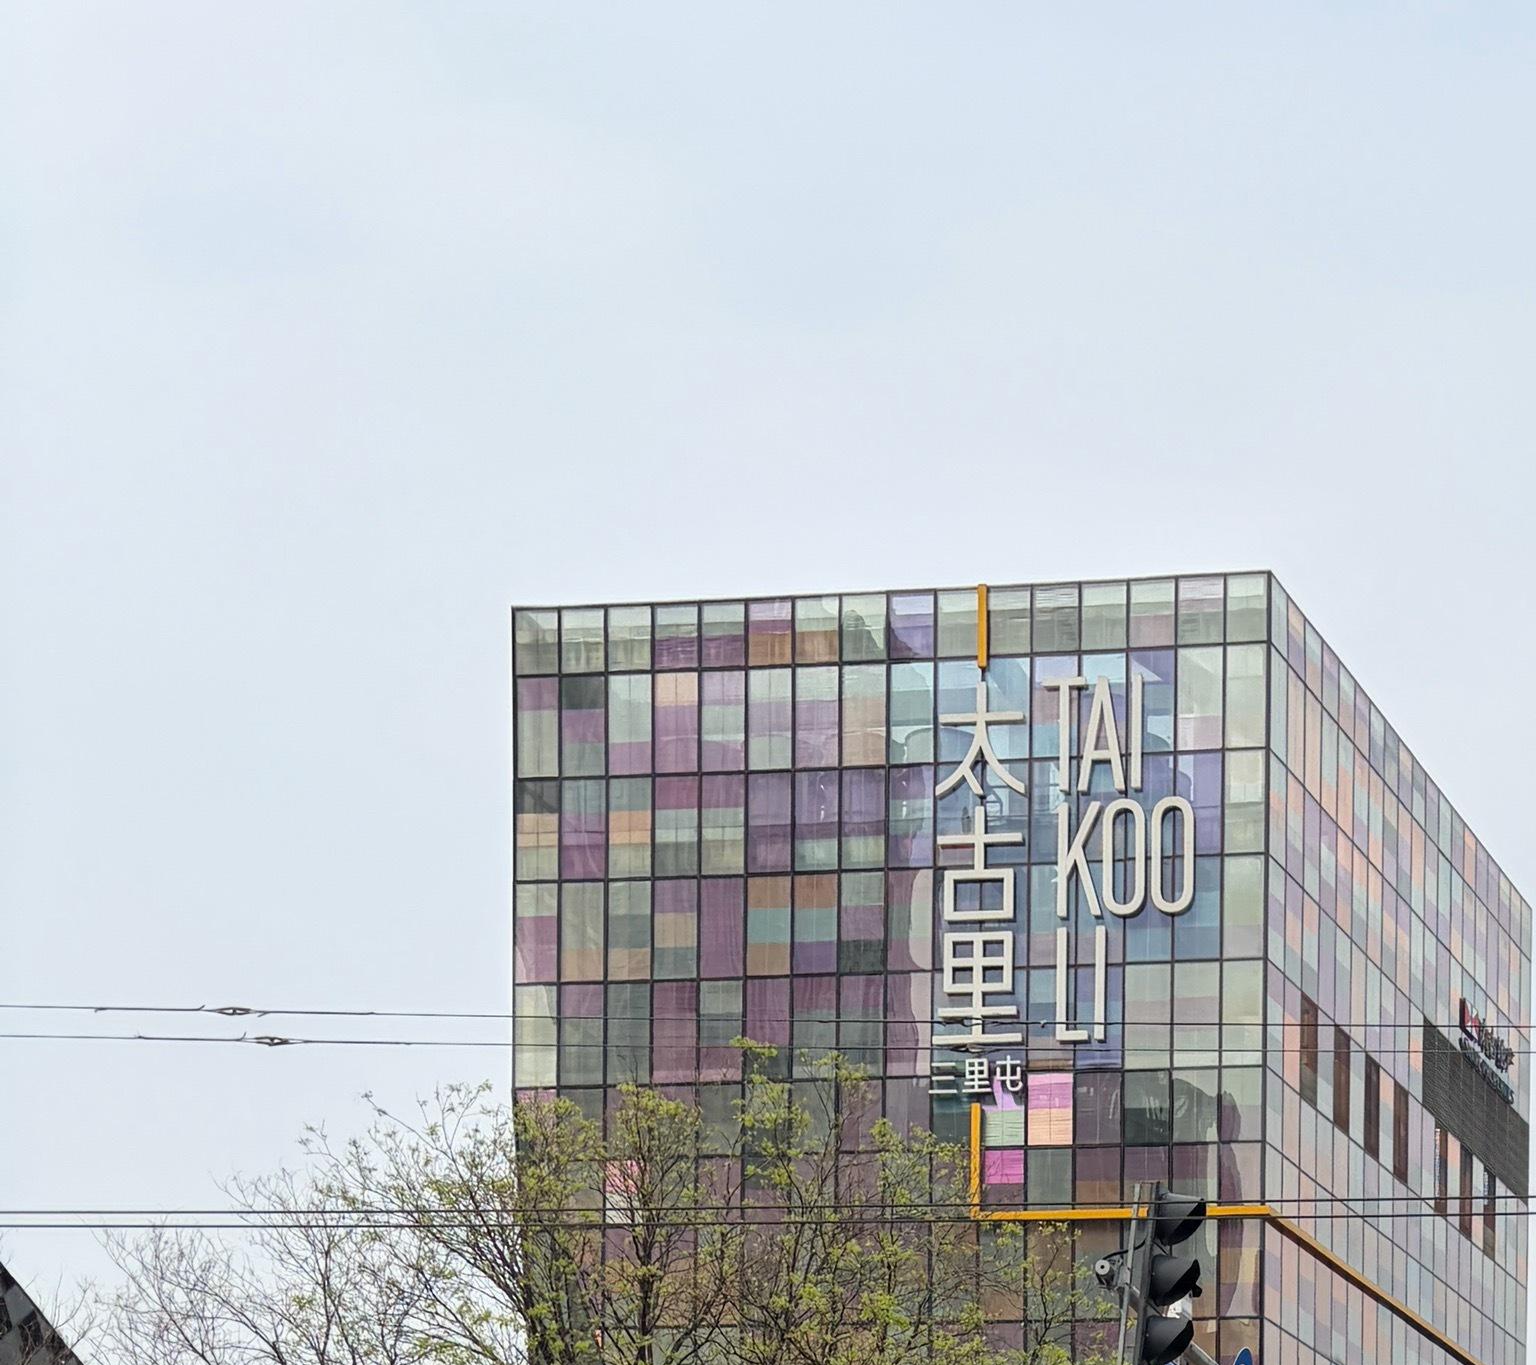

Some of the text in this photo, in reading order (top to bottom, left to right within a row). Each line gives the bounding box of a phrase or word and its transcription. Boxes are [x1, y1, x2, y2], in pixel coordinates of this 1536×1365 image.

[1041, 671, 1144, 794] TAI
[931, 681, 1026, 1046] 太古里
[1055, 796, 1195, 919] KOO
[1055, 925, 1106, 1043] LI
[928, 1055, 1023, 1094] 三里屯
